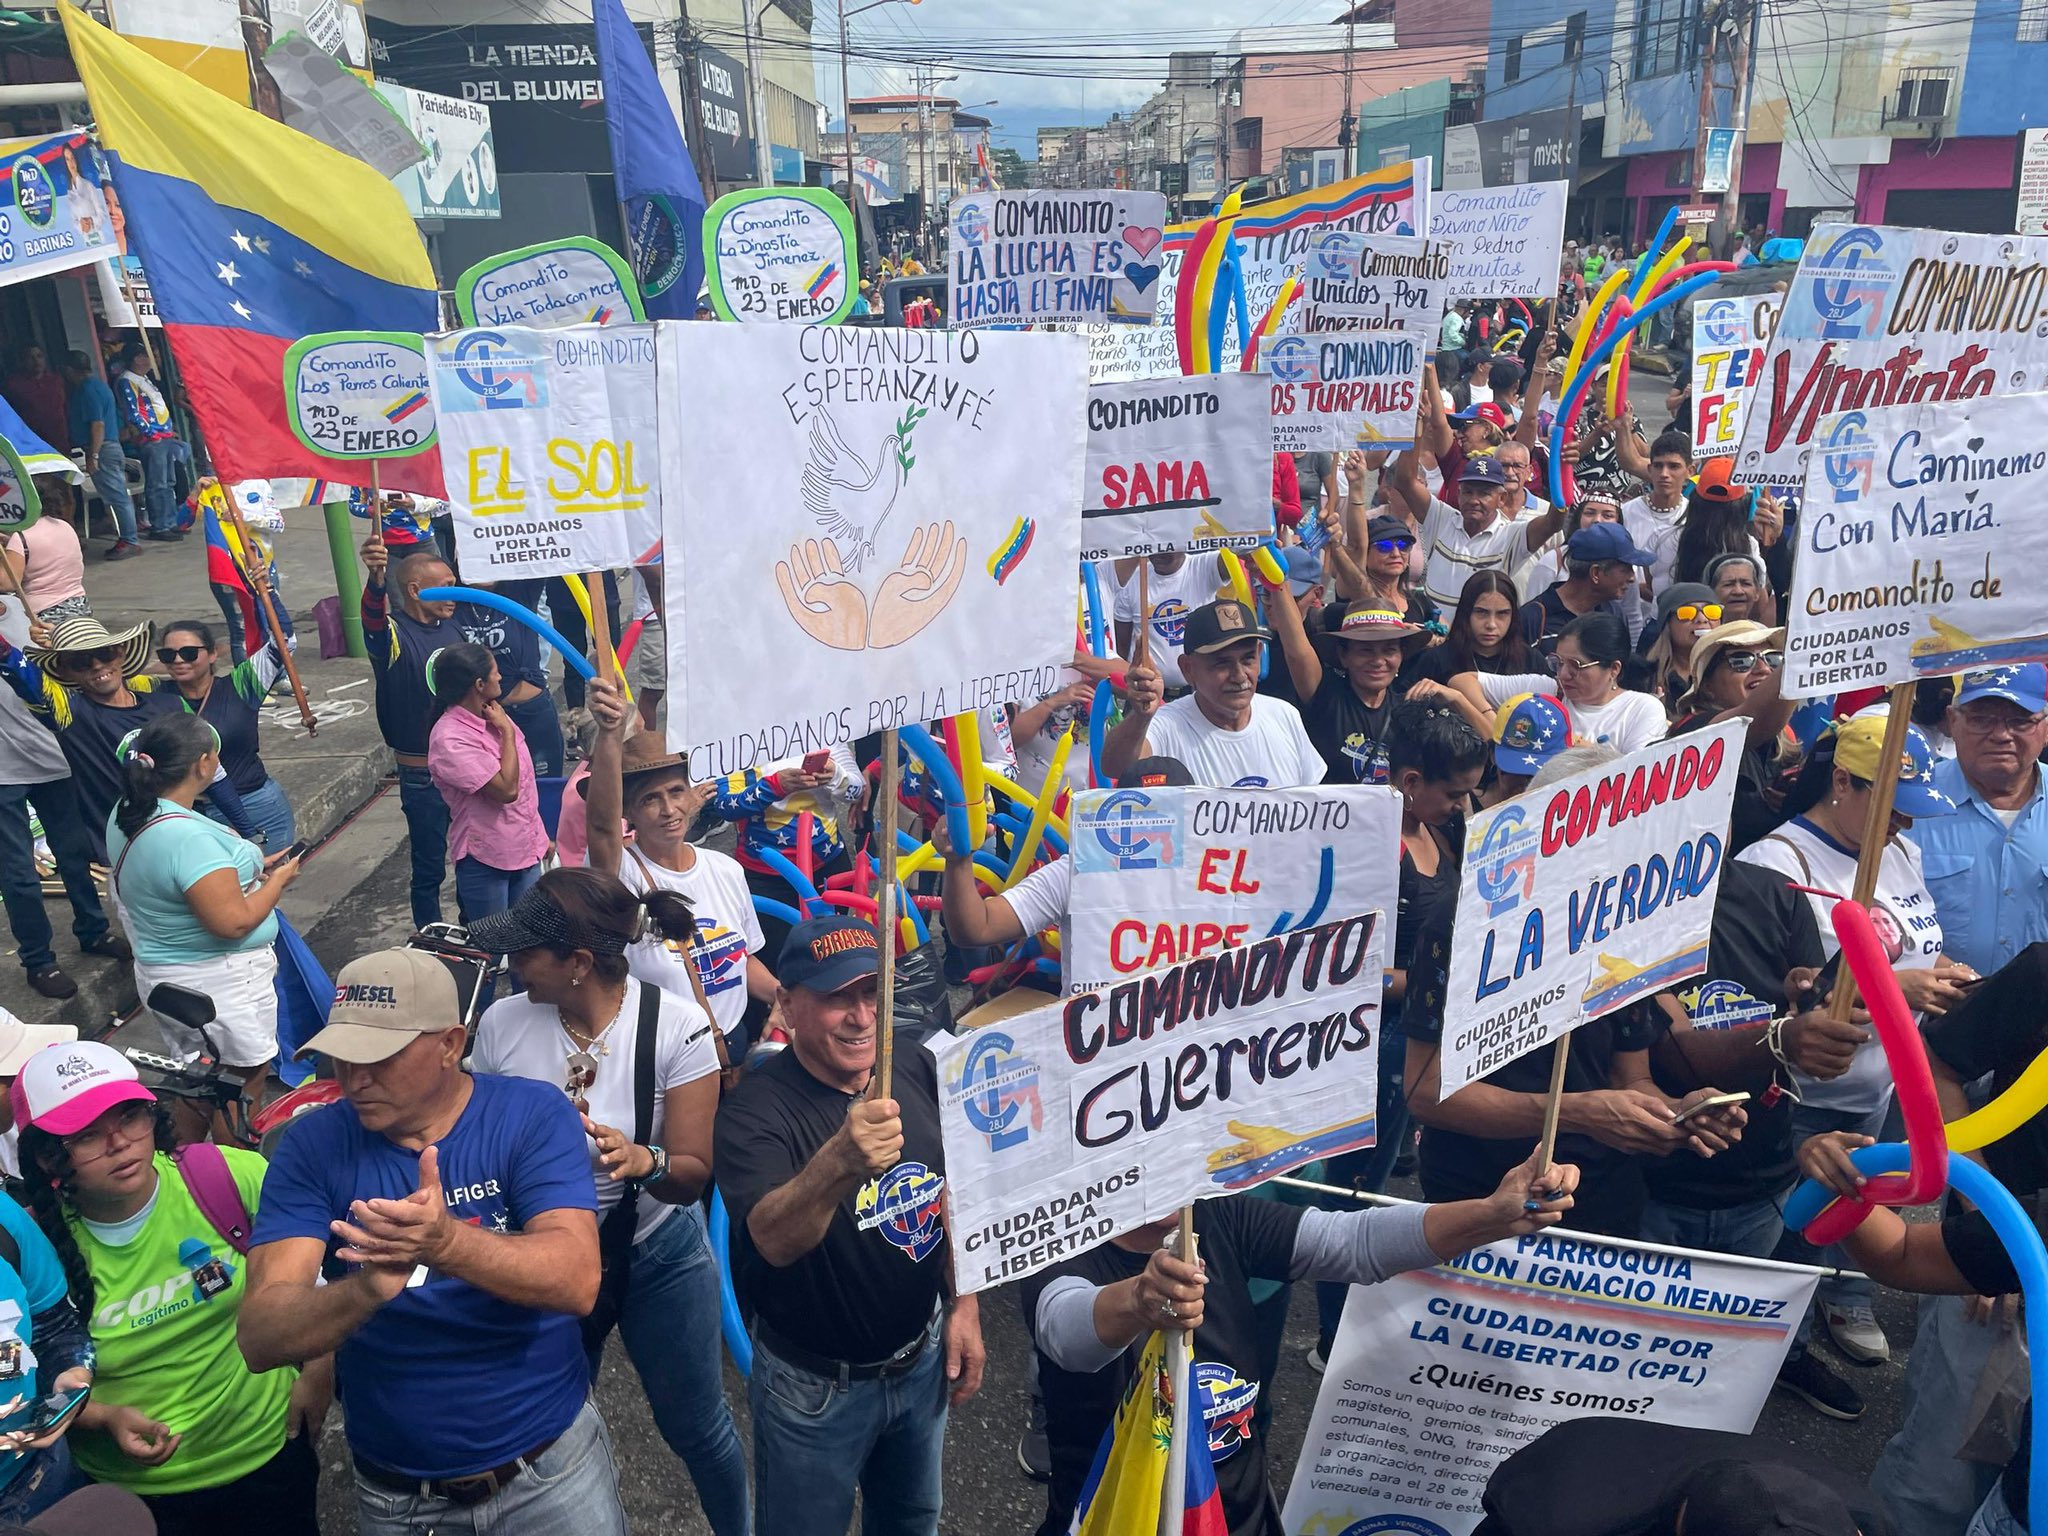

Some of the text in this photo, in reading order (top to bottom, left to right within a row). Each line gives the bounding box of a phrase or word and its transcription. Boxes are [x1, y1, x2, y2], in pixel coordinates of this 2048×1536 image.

[469, 44, 597, 66] LA TIENDA
[417, 93, 482, 125] Variedades Ely
[461, 81, 511, 101] DEL
[1534, 138, 1572, 167] mystc
[21, 187, 35, 206] 23
[1443, 186, 1547, 214] Comandito
[1678, 210, 1716, 218] ARNICERIA
[641, 201, 654, 231] ENERO
[730, 209, 811, 236] Comandito
[1429, 212, 1533, 234] Divino Niño
[24, 231, 74, 257] BARINAS
[718, 236, 738, 257] La
[1360, 239, 1449, 280] Comandito
[957, 244, 986, 286] LA
[996, 240, 1076, 278] LUCHA
[1092, 240, 1123, 273] ES
[1450, 256, 1524, 278] rinitas
[481, 261, 569, 303] Comandito
[740, 281, 790, 313] 23 DE
[956, 276, 1116, 322] HASTA EL FINAL
[1312, 277, 1428, 309] Unidos Por
[1449, 278, 1541, 295] asta el Final
[1887, 258, 2048, 335] COMANDITO
[485, 304, 525, 327] Vzla
[589, 279, 622, 299] MCM
[776, 296, 835, 321] ENERO
[1827, 308, 1845, 318] 28J
[309, 351, 397, 373] Comandito
[556, 336, 655, 368] COMANDITO
[799, 325, 980, 365] COMANDITO
[1319, 339, 1414, 383] COMANDITO
[300, 372, 429, 395] Los Perros Caliente
[483, 387, 498, 395] 28J
[782, 366, 939, 424] ESPERANZA
[956, 388, 995, 431] FÉ
[1272, 380, 1414, 415] OS TURPIALES
[312, 414, 358, 440] 23 DE
[1088, 391, 1219, 432] COMANDITO
[1696, 389, 1740, 446] FÉ
[343, 428, 418, 452] ENERO
[467, 436, 650, 503] EL SOL
[1886, 430, 2047, 490] Caminemo
[1102, 460, 1211, 510] SAMA
[473, 517, 584, 540] CIUDADANOS
[495, 535, 557, 552] POR LA
[1124, 536, 1257, 555] POR LA LIBERTAD
[1811, 512, 1874, 554] Con
[490, 546, 572, 566] LIBERTAD
[1805, 551, 2003, 617] Comandito de
[1790, 621, 1911, 653] CIUDADANOS
[1798, 661, 1888, 689] LIBERTAD
[1809, 648, 1875, 668] POR LA
[689, 665, 1056, 784] CIUDADANOS POR LA LIBERTAD
[1540, 737, 1725, 858] COMANDO
[1192, 800, 1350, 836] COMANDITO
[1196, 848, 1260, 895] EL
[1475, 831, 1722, 1003] LA VERDAD
[346, 985, 396, 1003] DIESEL
[1062, 912, 1377, 1065] COMANDITO
[1455, 984, 1566, 1052] CIUDADANOS
[1477, 1012, 1540, 1056] POR LA
[1466, 1025, 1549, 1081] LIBERTAD
[947, 1083, 985, 1106] CIUDADANOS
[987, 1079, 1000, 1087] POR
[1012, 1065, 1041, 1079] LIBERTAD
[988, 1119, 1004, 1131] 28J
[445, 1178, 502, 1208] LFIGER
[964, 1166, 1141, 1253] CIUDADANOS
[909, 1229, 925, 1244] 28J
[999, 1203, 1098, 1257] POR LA
[983, 1217, 1115, 1284] LIBERTAD
[1516, 1233, 1694, 1282] PARROQUIA
[96, 1271, 192, 1327] COP
[1438, 1250, 1789, 1320] MÓN IGNACIO MENDEZ
[131, 1299, 189, 1328] Legítimo
[1426, 1297, 1715, 1361] CIUDADANOS POR
[1408, 1322, 1708, 1387] LA LIBERTAD (CPL)
[1342, 1379, 1391, 1399] Somos
[1396, 1392, 1413, 1402] un
[1417, 1396, 1465, 1414] equipo
[1469, 1405, 1487, 1417] de
[1490, 1408, 1538, 1426] trabajo
[1408, 1361, 1655, 1416] ¿Quiénes somos?
[1336, 1397, 1413, 1422] magisterio,
[1424, 1416, 1484, 1435] gremios,
[1325, 1431, 1492, 1470] estudiantes, entre otros.
[1331, 1414, 1516, 1456] comunales, ONG, transpo
[1315, 1463, 1364, 1478] barinés
[1369, 1472, 1401, 1487] para
[1407, 1479, 1421, 1490] el
[1426, 1482, 1445, 1494] 28
[1451, 1486, 1470, 1498] de
[1320, 1447, 1489, 1484] la organización, direcció
[1310, 1480, 1380, 1498] Venezuela
[1383, 1491, 1392, 1500] a
[1395, 1493, 1432, 1510] partir
[1435, 1500, 1453, 1511] de
